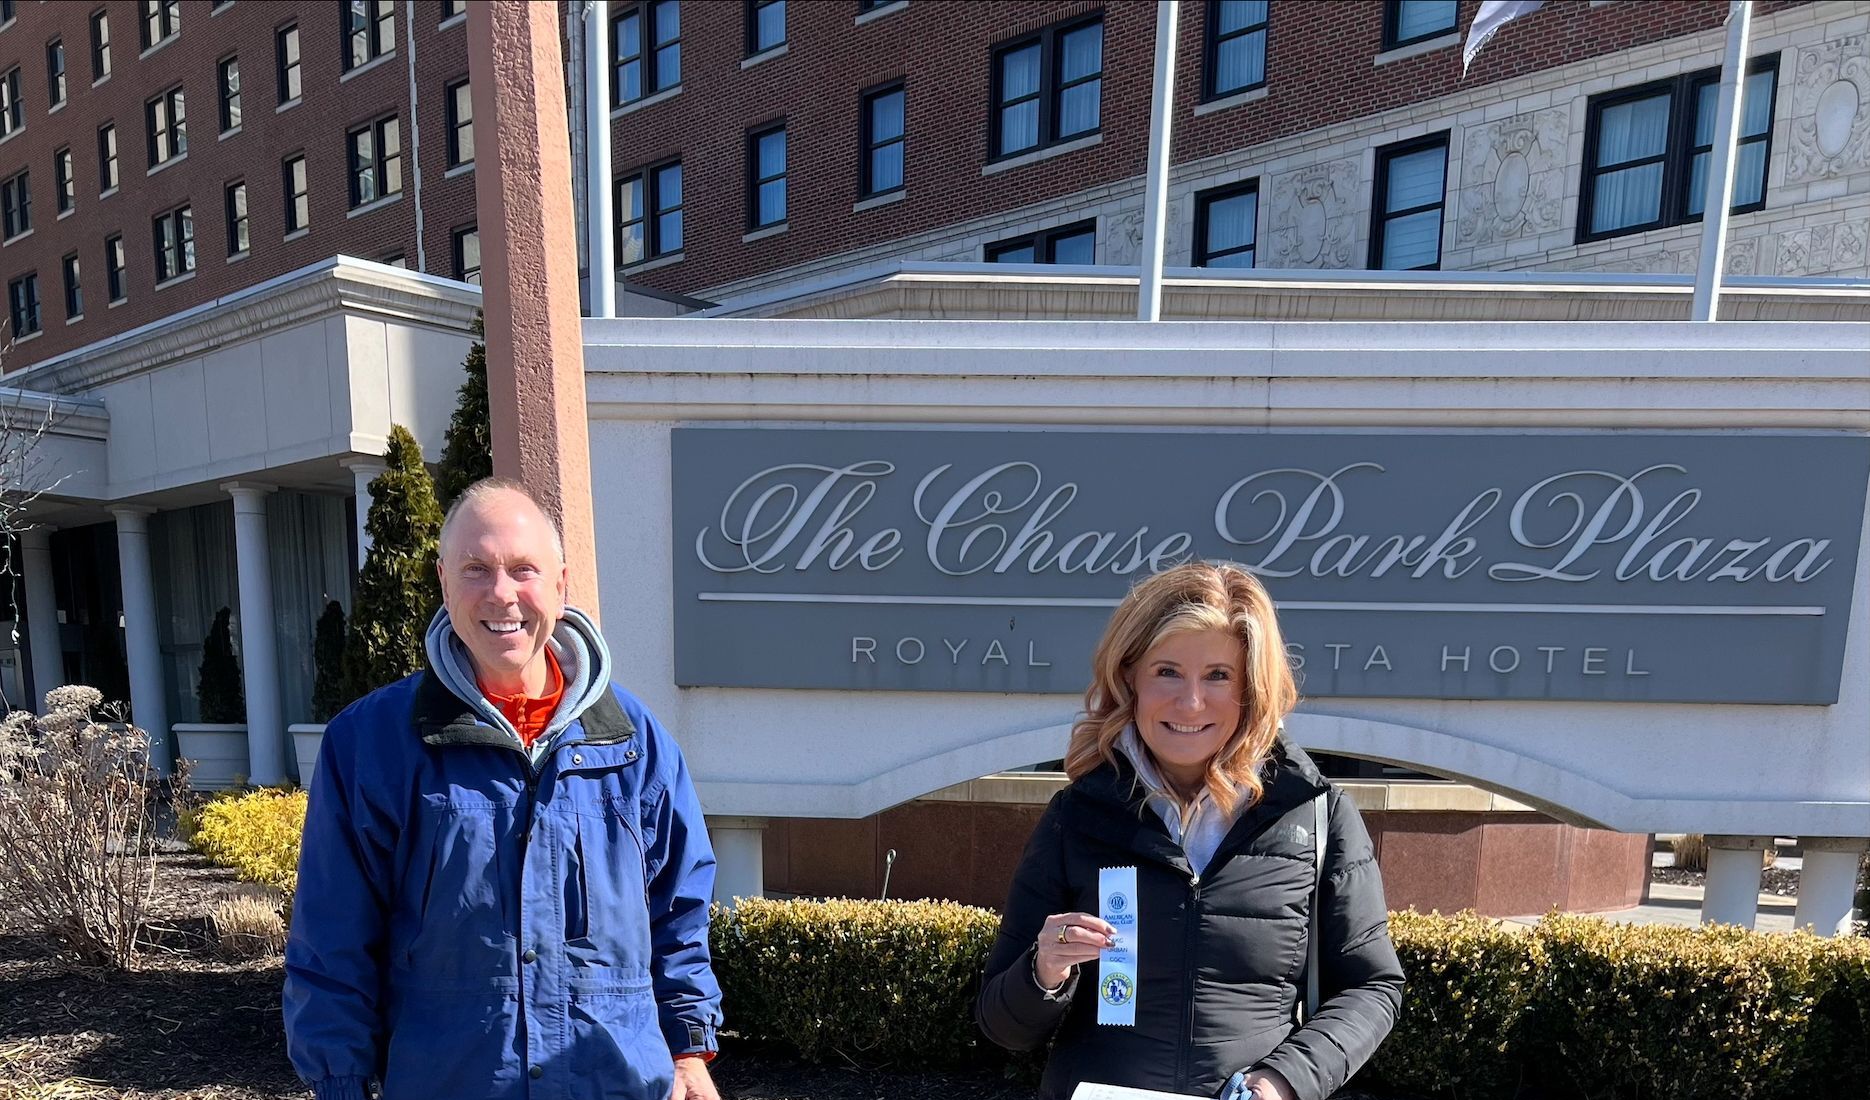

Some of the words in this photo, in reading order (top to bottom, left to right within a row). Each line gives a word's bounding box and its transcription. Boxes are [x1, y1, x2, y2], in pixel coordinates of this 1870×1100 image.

[695, 460, 904, 575] The
[913, 461, 1194, 576] Chase
[1203, 461, 1502, 580] Park
[1488, 463, 1834, 583] Plaza
[850, 636, 1052, 668] ROYAL
[1440, 644, 1650, 676] HOTEL
